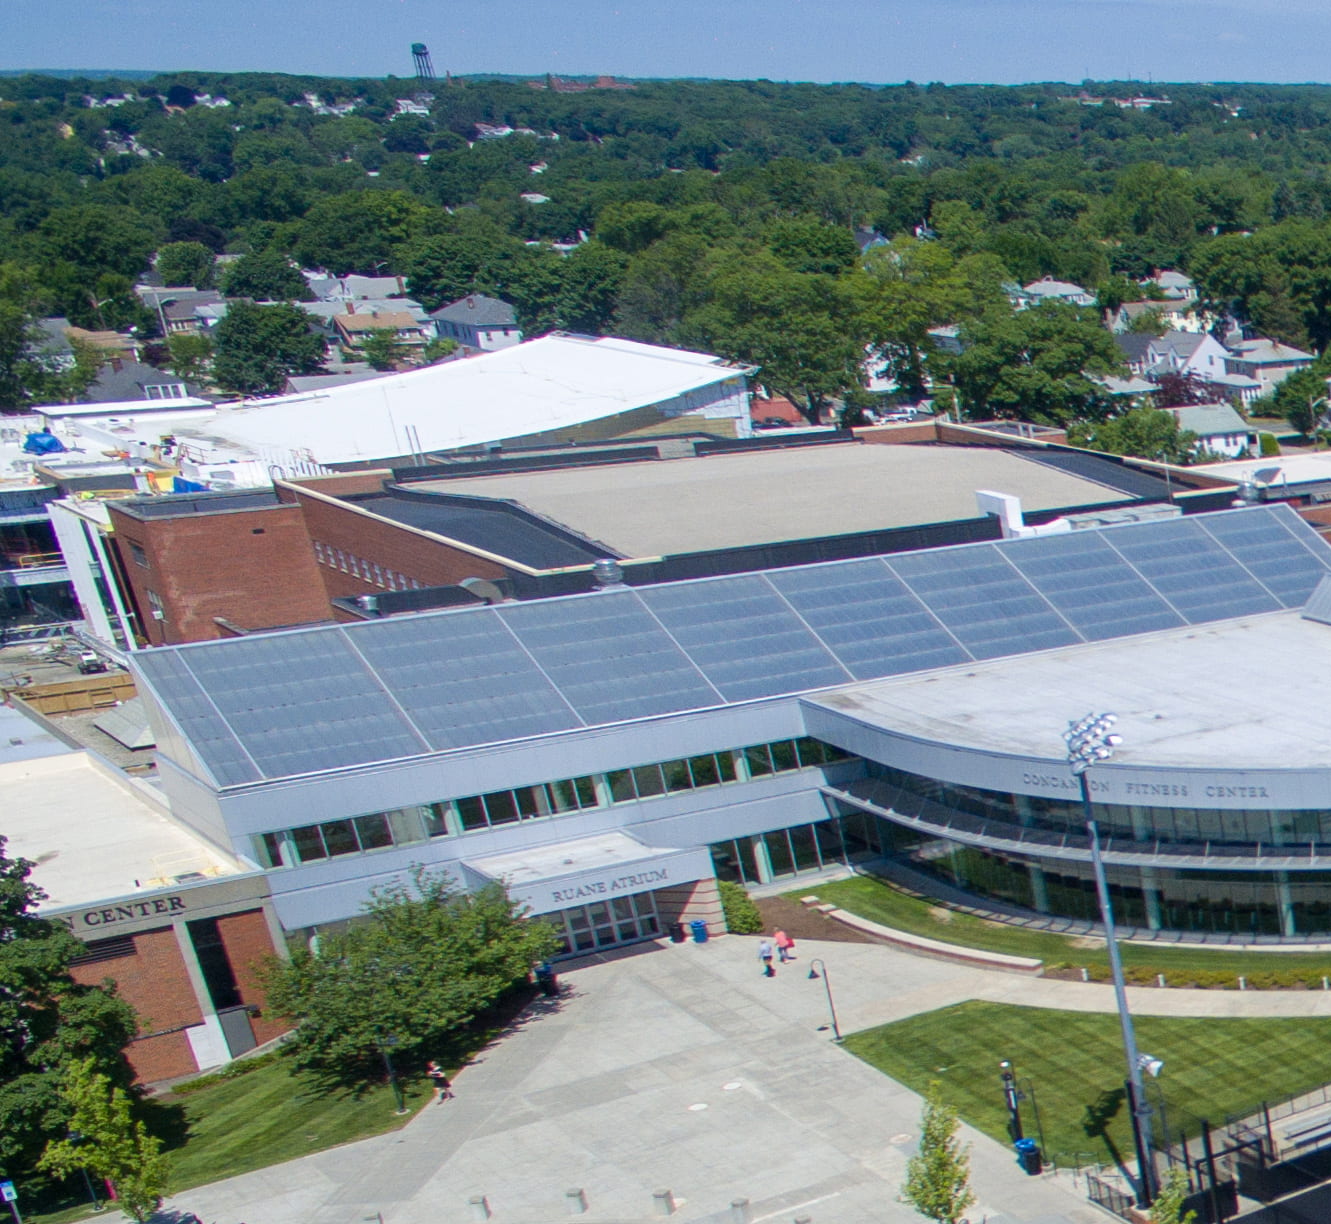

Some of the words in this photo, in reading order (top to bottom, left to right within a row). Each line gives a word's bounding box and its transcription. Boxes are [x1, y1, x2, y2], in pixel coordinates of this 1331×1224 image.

[1023, 773, 1110, 793] CONCANON
[1126, 782, 1188, 797] FITNESS
[1205, 785, 1269, 799] CENTER
[552, 882, 607, 903] RUANE
[611, 868, 669, 891] ATRIUM
[84, 896, 186, 926] CENTER
